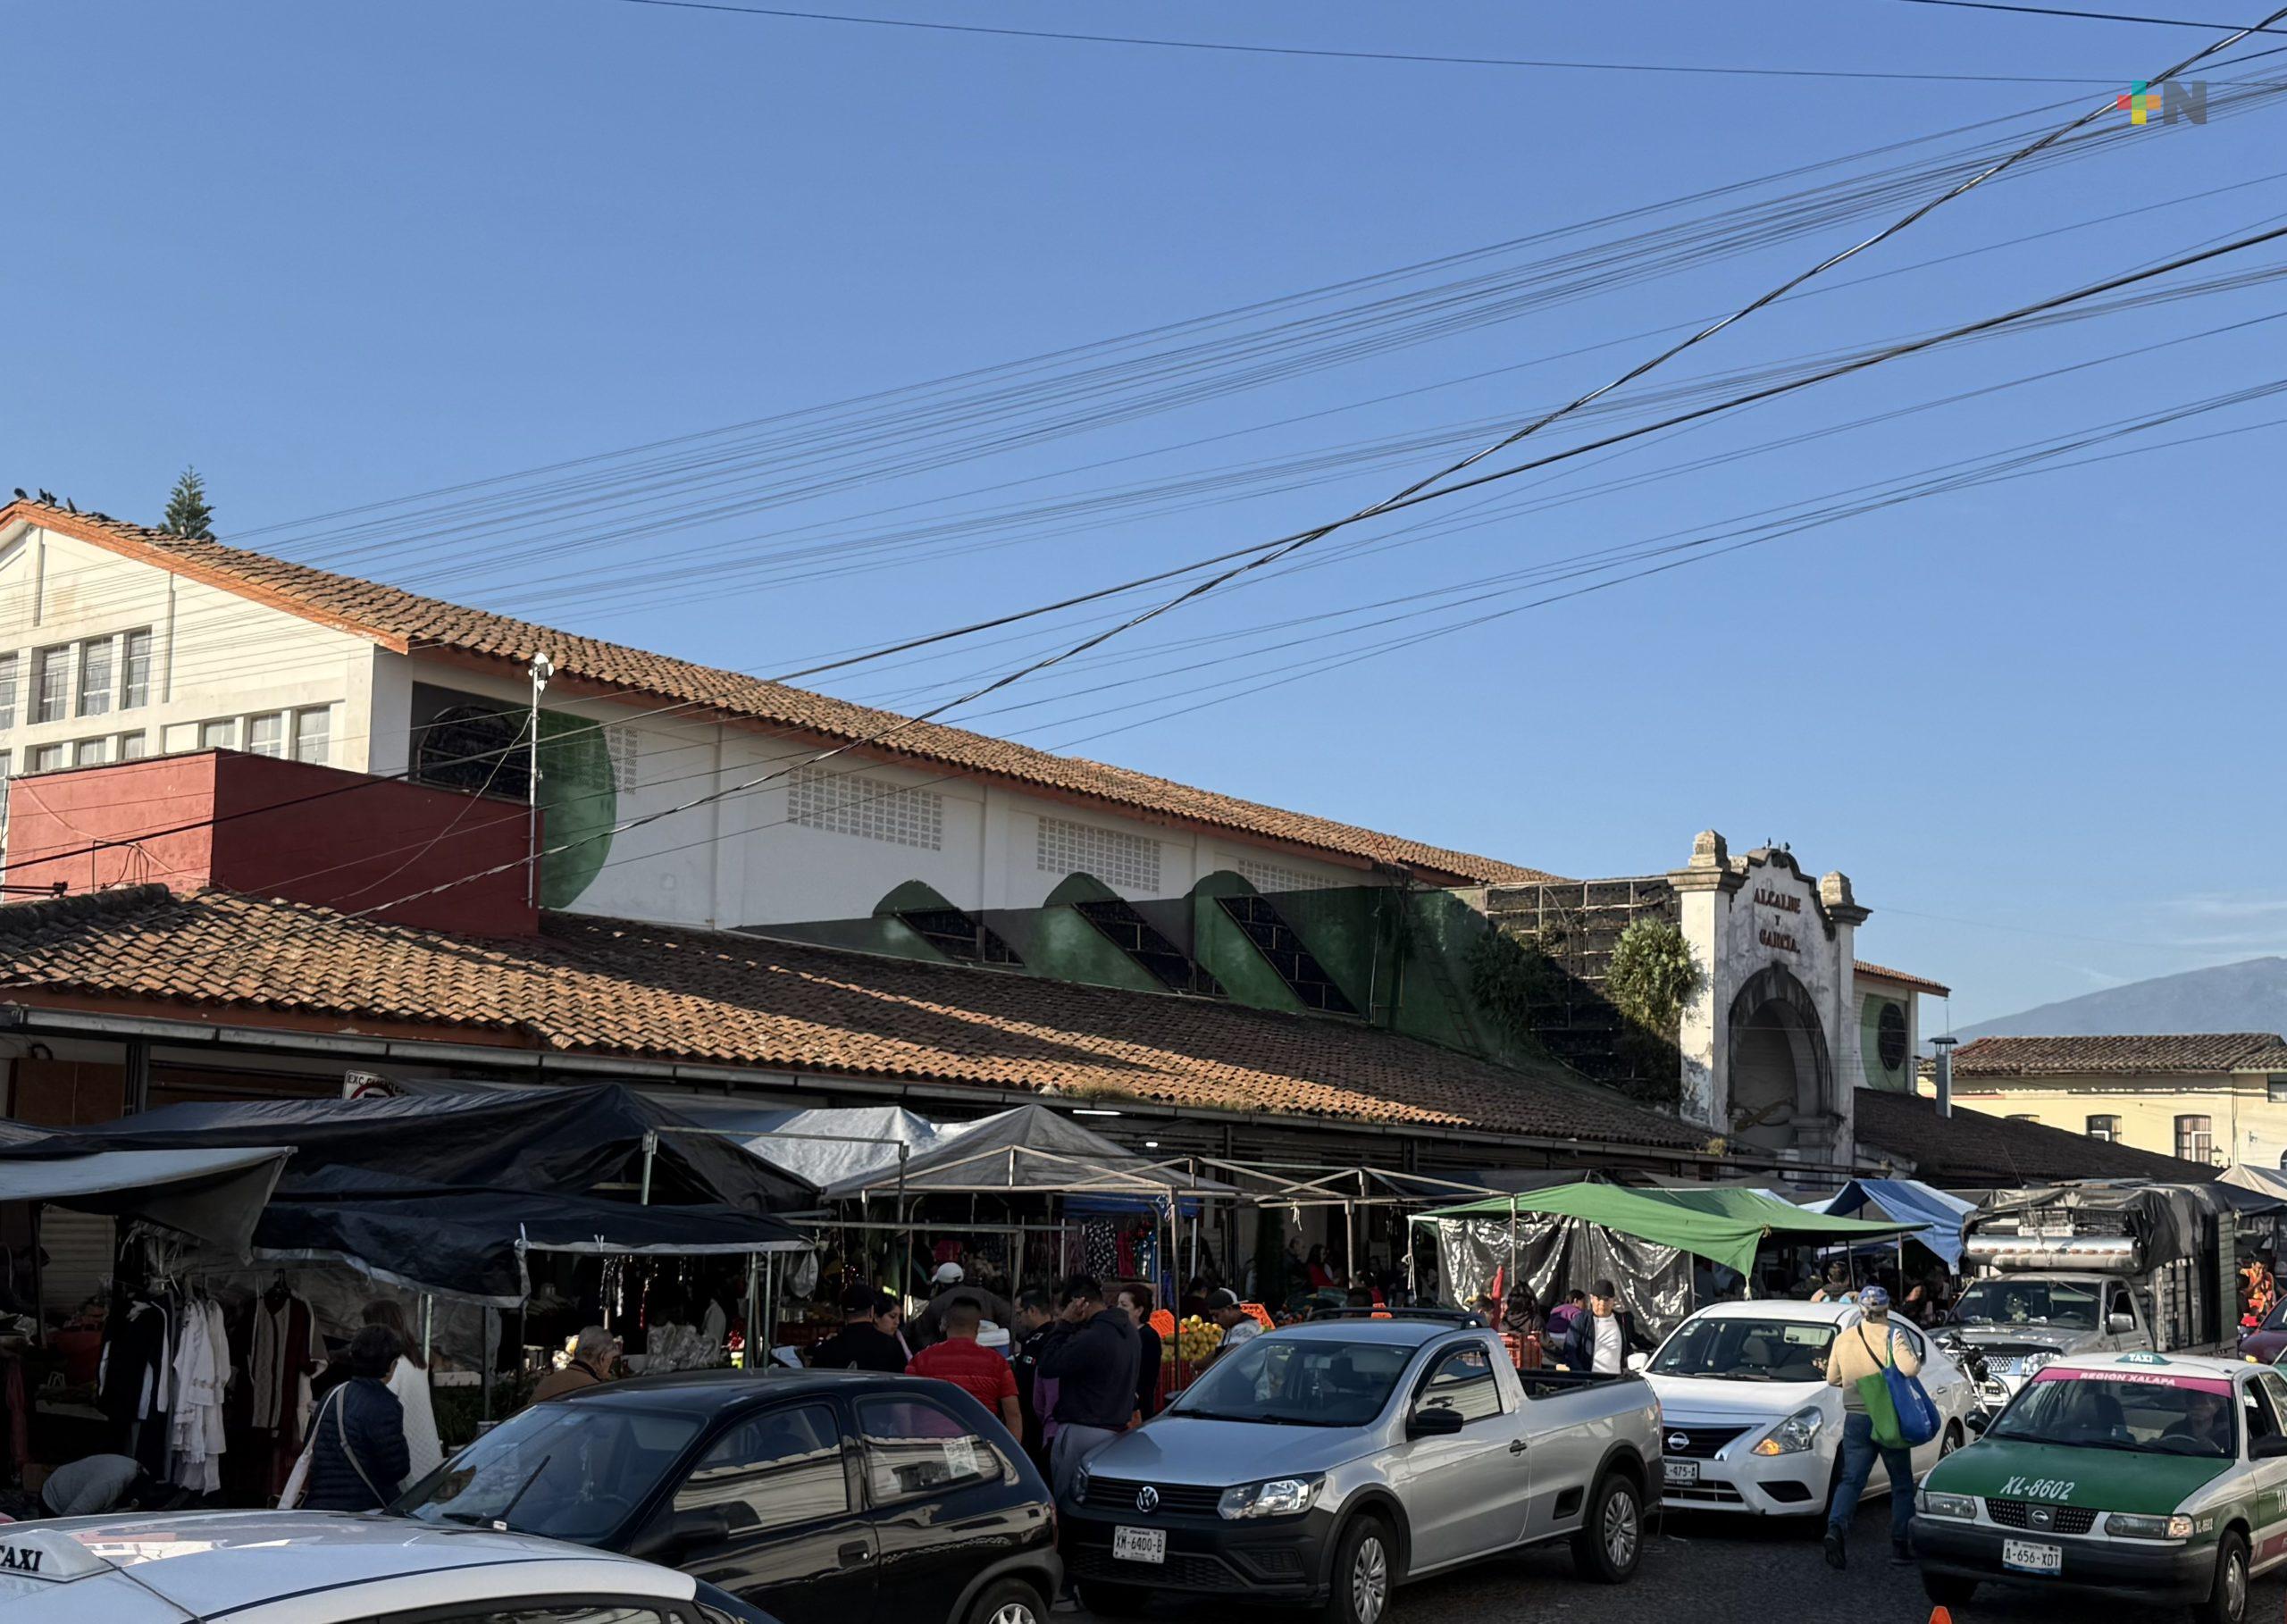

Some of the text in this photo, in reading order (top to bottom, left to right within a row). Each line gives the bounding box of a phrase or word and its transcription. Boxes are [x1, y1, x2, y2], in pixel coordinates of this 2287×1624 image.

[1774, 915, 1780, 926] Y
[2129, 1353, 2153, 1363] TAXI
[2128, 1374, 2176, 1385] XALAPA
[2000, 1477, 2075, 1500] XL-8602
[2005, 1547, 2060, 1567] A-656-XDT
